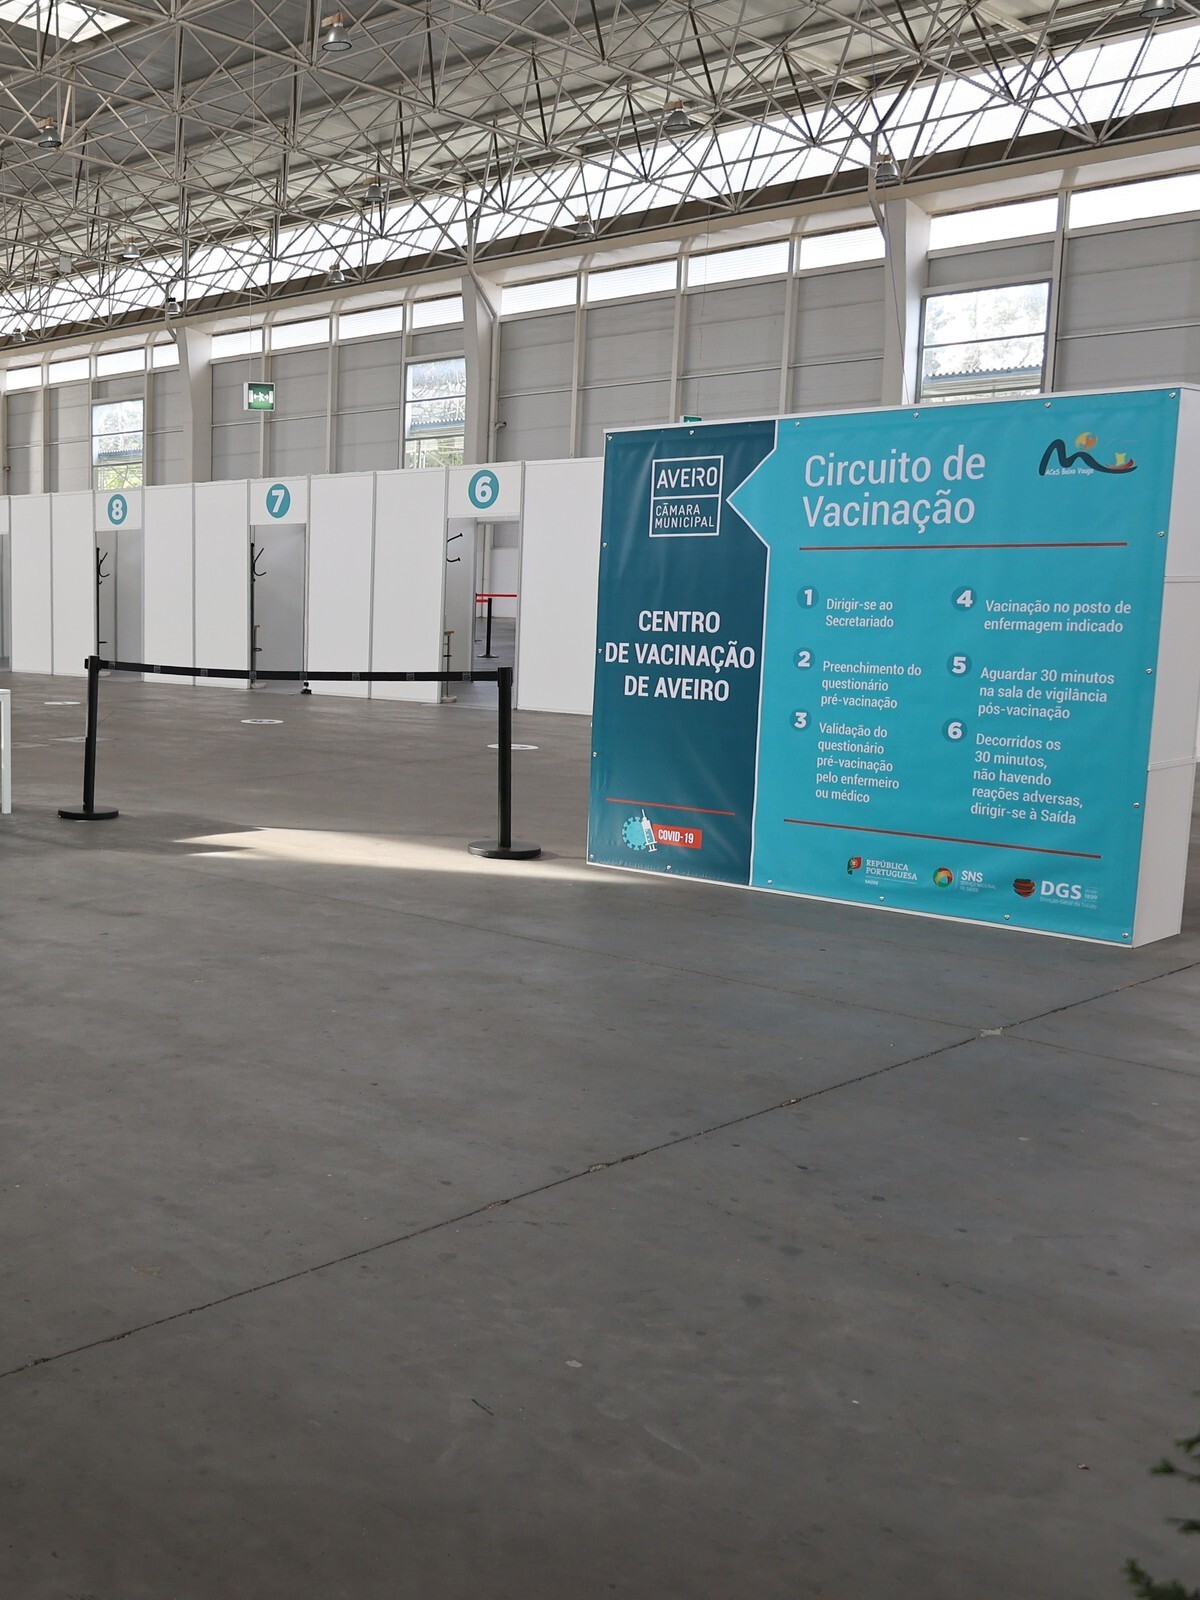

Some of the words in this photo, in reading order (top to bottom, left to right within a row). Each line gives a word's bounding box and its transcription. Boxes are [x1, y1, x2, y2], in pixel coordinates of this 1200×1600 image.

[804, 448, 932, 487] Circuito
[943, 444, 986, 482] de
[656, 466, 718, 489] AVEIRO
[475, 477, 493, 502] 6
[272, 489, 285, 513] 7
[111, 500, 125, 521] 8
[802, 489, 976, 534] Vacinação
[654, 516, 714, 528] MUNICIPAL
[804, 589, 813, 606] 1
[826, 598, 877, 612] Dirigir-se
[879, 601, 894, 611] ao
[956, 590, 973, 608] 4
[985, 599, 1050, 615] Vacinação
[1053, 602, 1070, 614] no
[1073, 602, 1111, 617] posto
[1114, 600, 1132, 614] de
[638, 610, 721, 633] CENTRO
[825, 615, 894, 628] Secretariado
[984, 618, 1063, 634] enfermagem
[1066, 619, 1124, 634] indicado
[605, 642, 629, 664] DE
[634, 640, 755, 673] VACINAÇÃO
[797, 651, 811, 668] 2
[952, 656, 967, 674] 5
[822, 660, 904, 676] Preenchimento
[907, 664, 922, 677] do
[980, 667, 1037, 684] Aguardar
[1040, 670, 1058, 682] 30
[1060, 670, 1115, 685] minutos
[624, 675, 649, 696] DE
[654, 677, 730, 701] AVEIRO
[821, 678, 889, 693] questionário
[979, 686, 994, 697] na
[998, 685, 1023, 699] sala
[1026, 686, 1042, 700] de
[1045, 687, 1108, 703] vigilância
[820, 694, 898, 709] pré-vacinação
[794, 712, 807, 728] 3
[978, 703, 1070, 720] pós-vacinação
[818, 722, 870, 738] Validação
[873, 725, 888, 738] do
[947, 722, 962, 740] 6
[818, 740, 885, 755] questionário
[976, 734, 1042, 750] Decorridos
[1046, 739, 1061, 750] os
[816, 755, 893, 773] pré-vacinação
[974, 751, 991, 763] 30
[994, 752, 1048, 770] minutos,
[816, 771, 838, 786] pelo
[840, 773, 900, 790] enfermeiro
[973, 768, 996, 782] não
[999, 769, 1051, 786] havendo
[815, 790, 828, 800] ou
[830, 789, 870, 804] médico
[972, 786, 1019, 802] reações
[1022, 788, 1084, 809] adversas,
[970, 803, 1026, 820] dirigir-se
[1028, 808, 1038, 821] à
[1040, 810, 1076, 824] Saída
[658, 829, 694, 844] COVID-19
[866, 859, 908, 872] REPÚBLICA
[866, 867, 918, 881] PORTUGUESA
[960, 870, 983, 882] SNS
[1040, 880, 1082, 900] DGS
